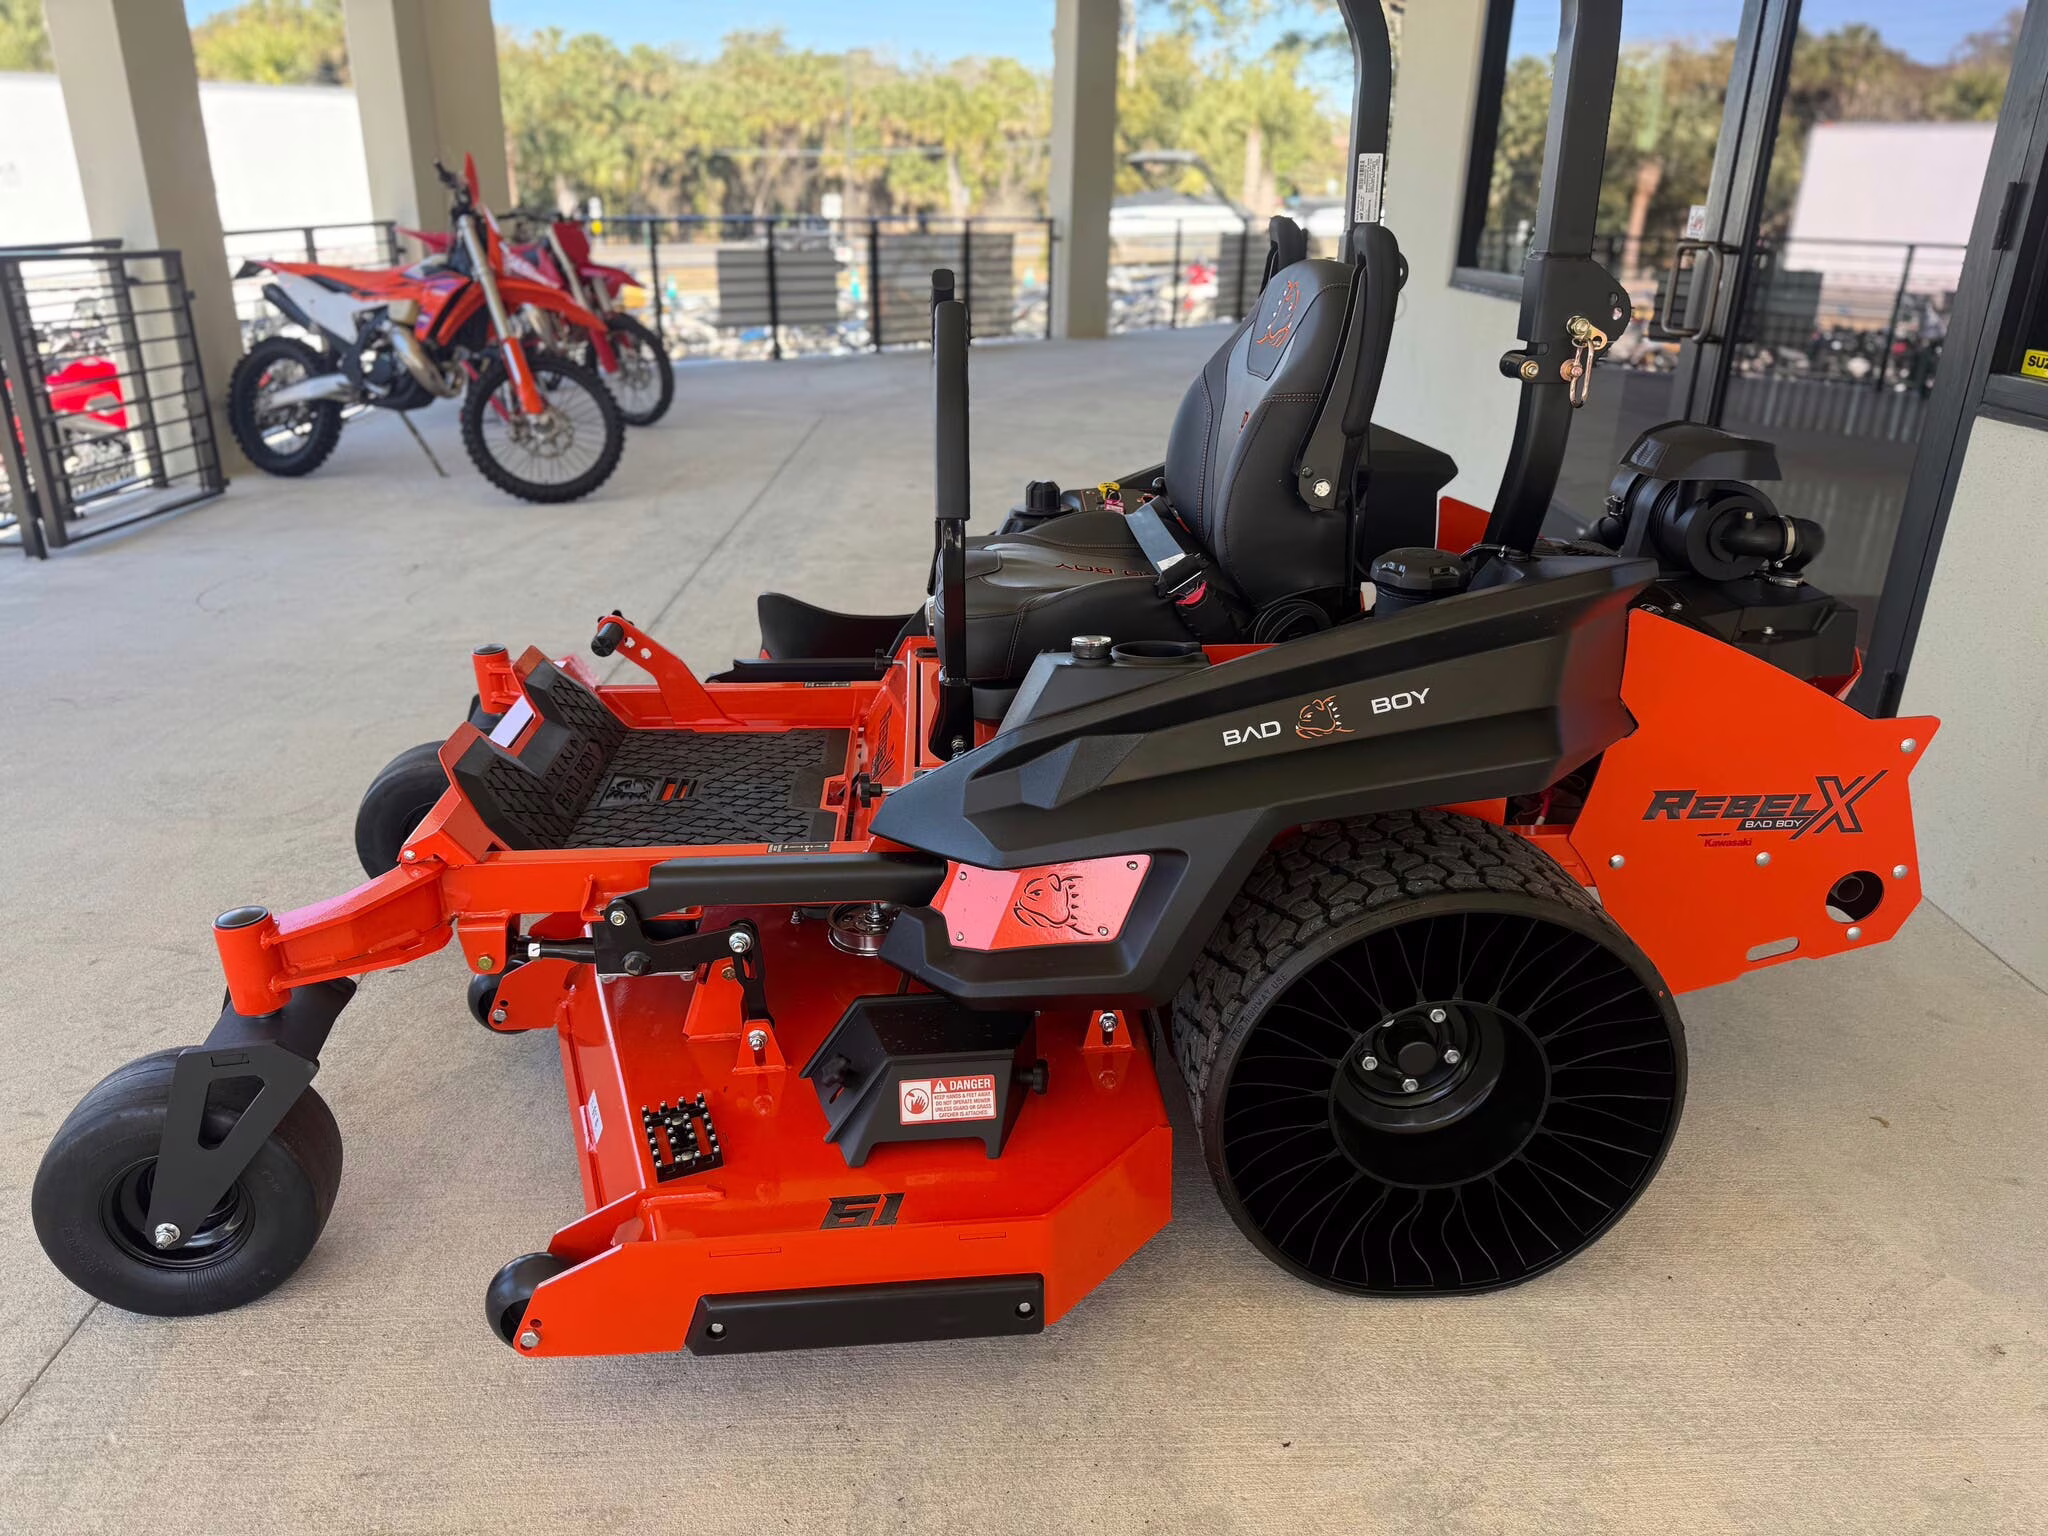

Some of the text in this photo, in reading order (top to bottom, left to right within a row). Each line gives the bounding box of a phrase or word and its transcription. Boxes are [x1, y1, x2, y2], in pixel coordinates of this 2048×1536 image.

[1222, 687, 1430, 746] BAD BOY
[555, 745, 597, 811] BAD BOY
[1745, 819, 1803, 828] BAD BOY
[1704, 838, 1752, 848] Kawasaki
[1243, 988, 1272, 1025] HIGHWAY
[1271, 972, 1288, 989] USE
[950, 1078, 991, 1091] DANGER
[820, 1193, 905, 1230] 61
